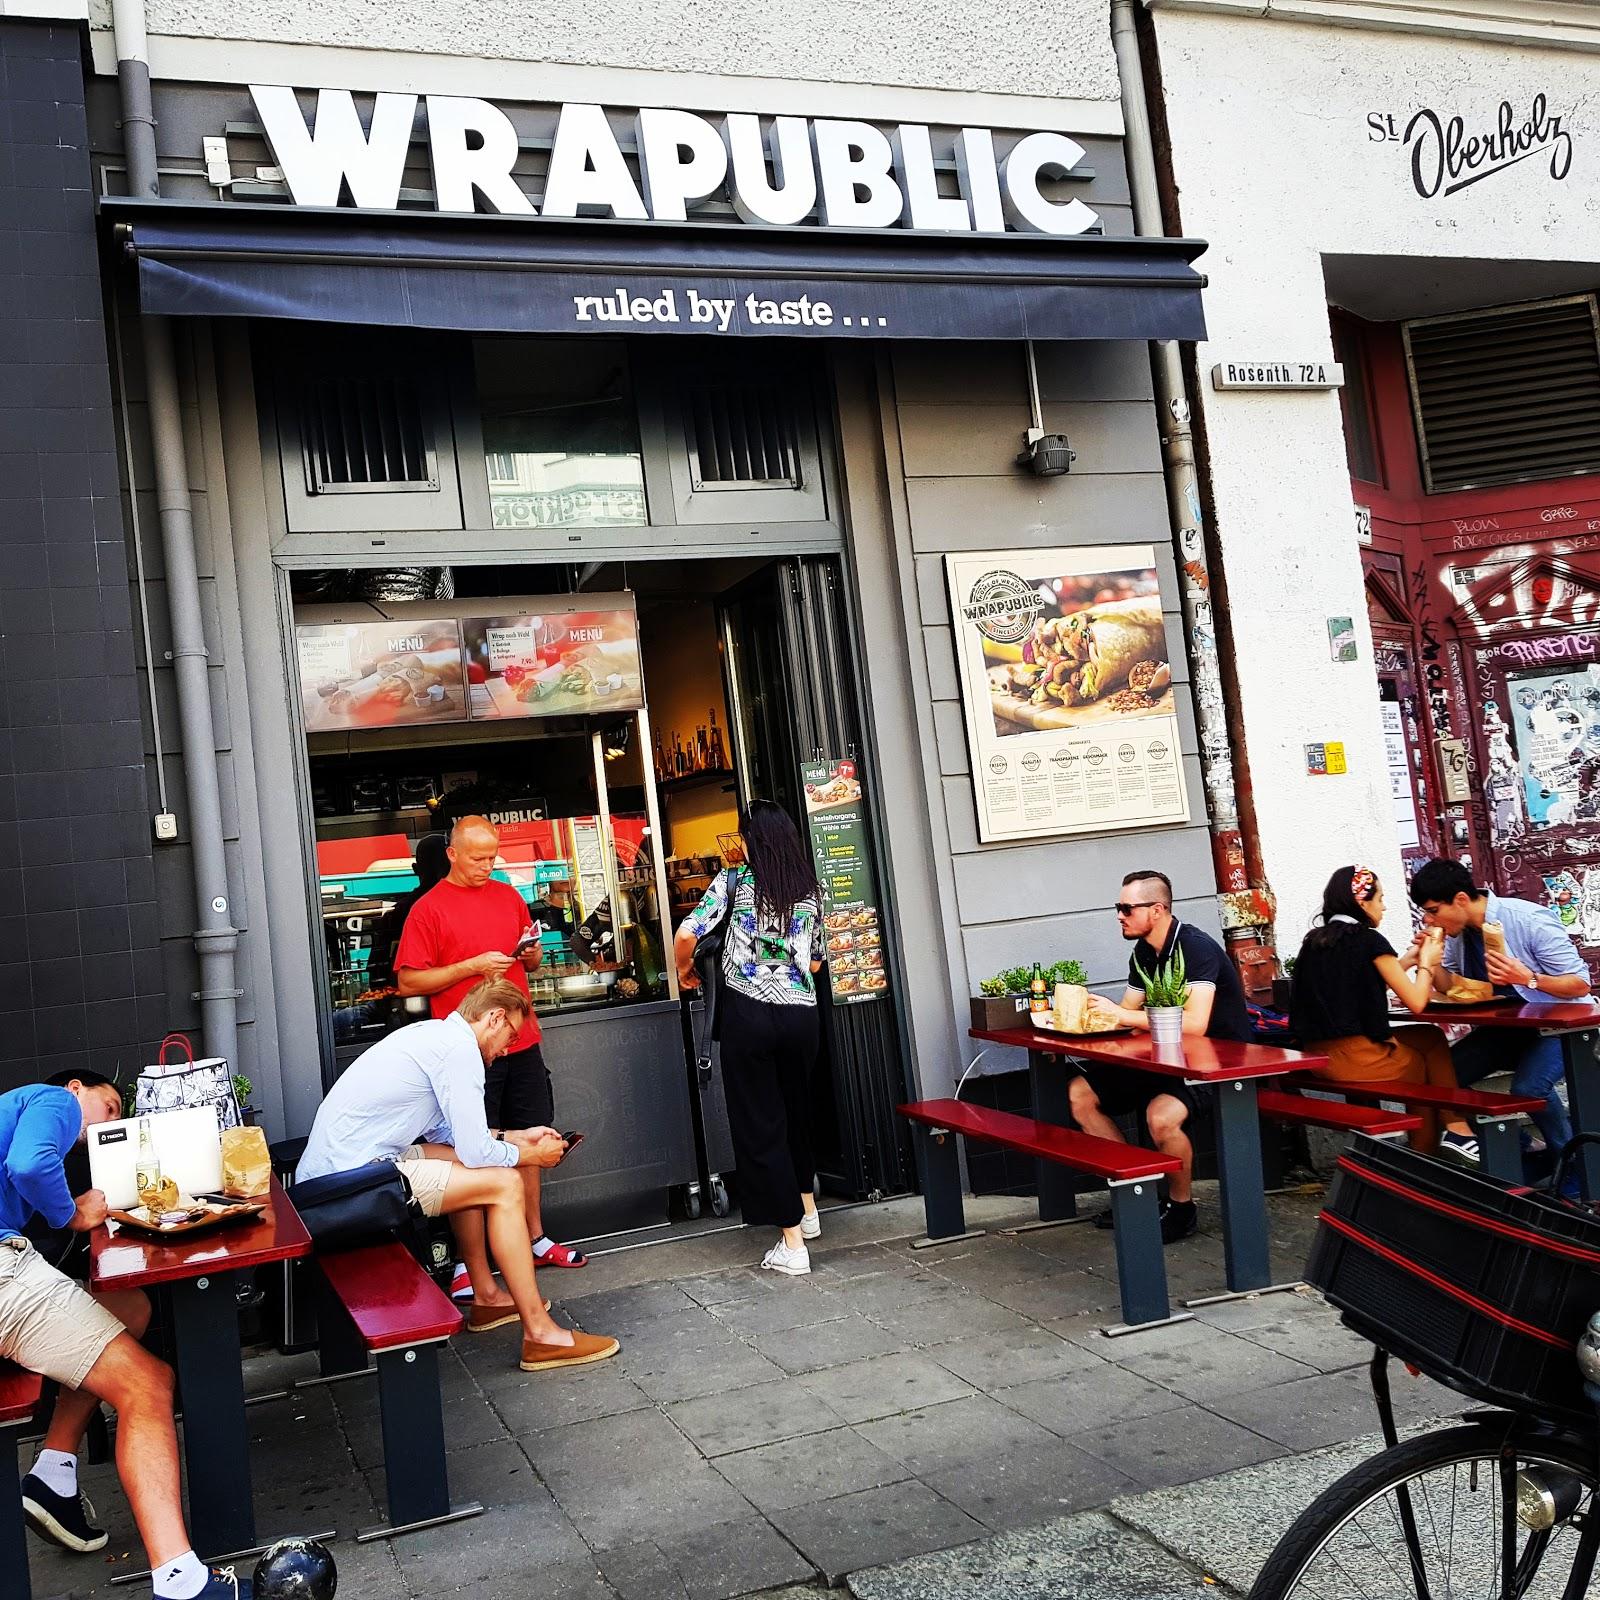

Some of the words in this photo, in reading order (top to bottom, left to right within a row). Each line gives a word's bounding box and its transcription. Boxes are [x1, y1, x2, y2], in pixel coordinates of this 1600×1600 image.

[1402, 92, 1573, 199] Oberholz
[248, 84, 1100, 235] WRAPUBLIC
[574, 288, 680, 323] ruled
[687, 289, 735, 331] by
[1228, 364, 1294, 383] Rosenth.
[1355, 511, 1370, 536] 72
[962, 593, 1044, 620] WRAPUBLIC
[387, 635, 424, 652] MENÜ
[570, 627, 604, 641] MENÜ
[806, 768, 826, 778] MENÜ
